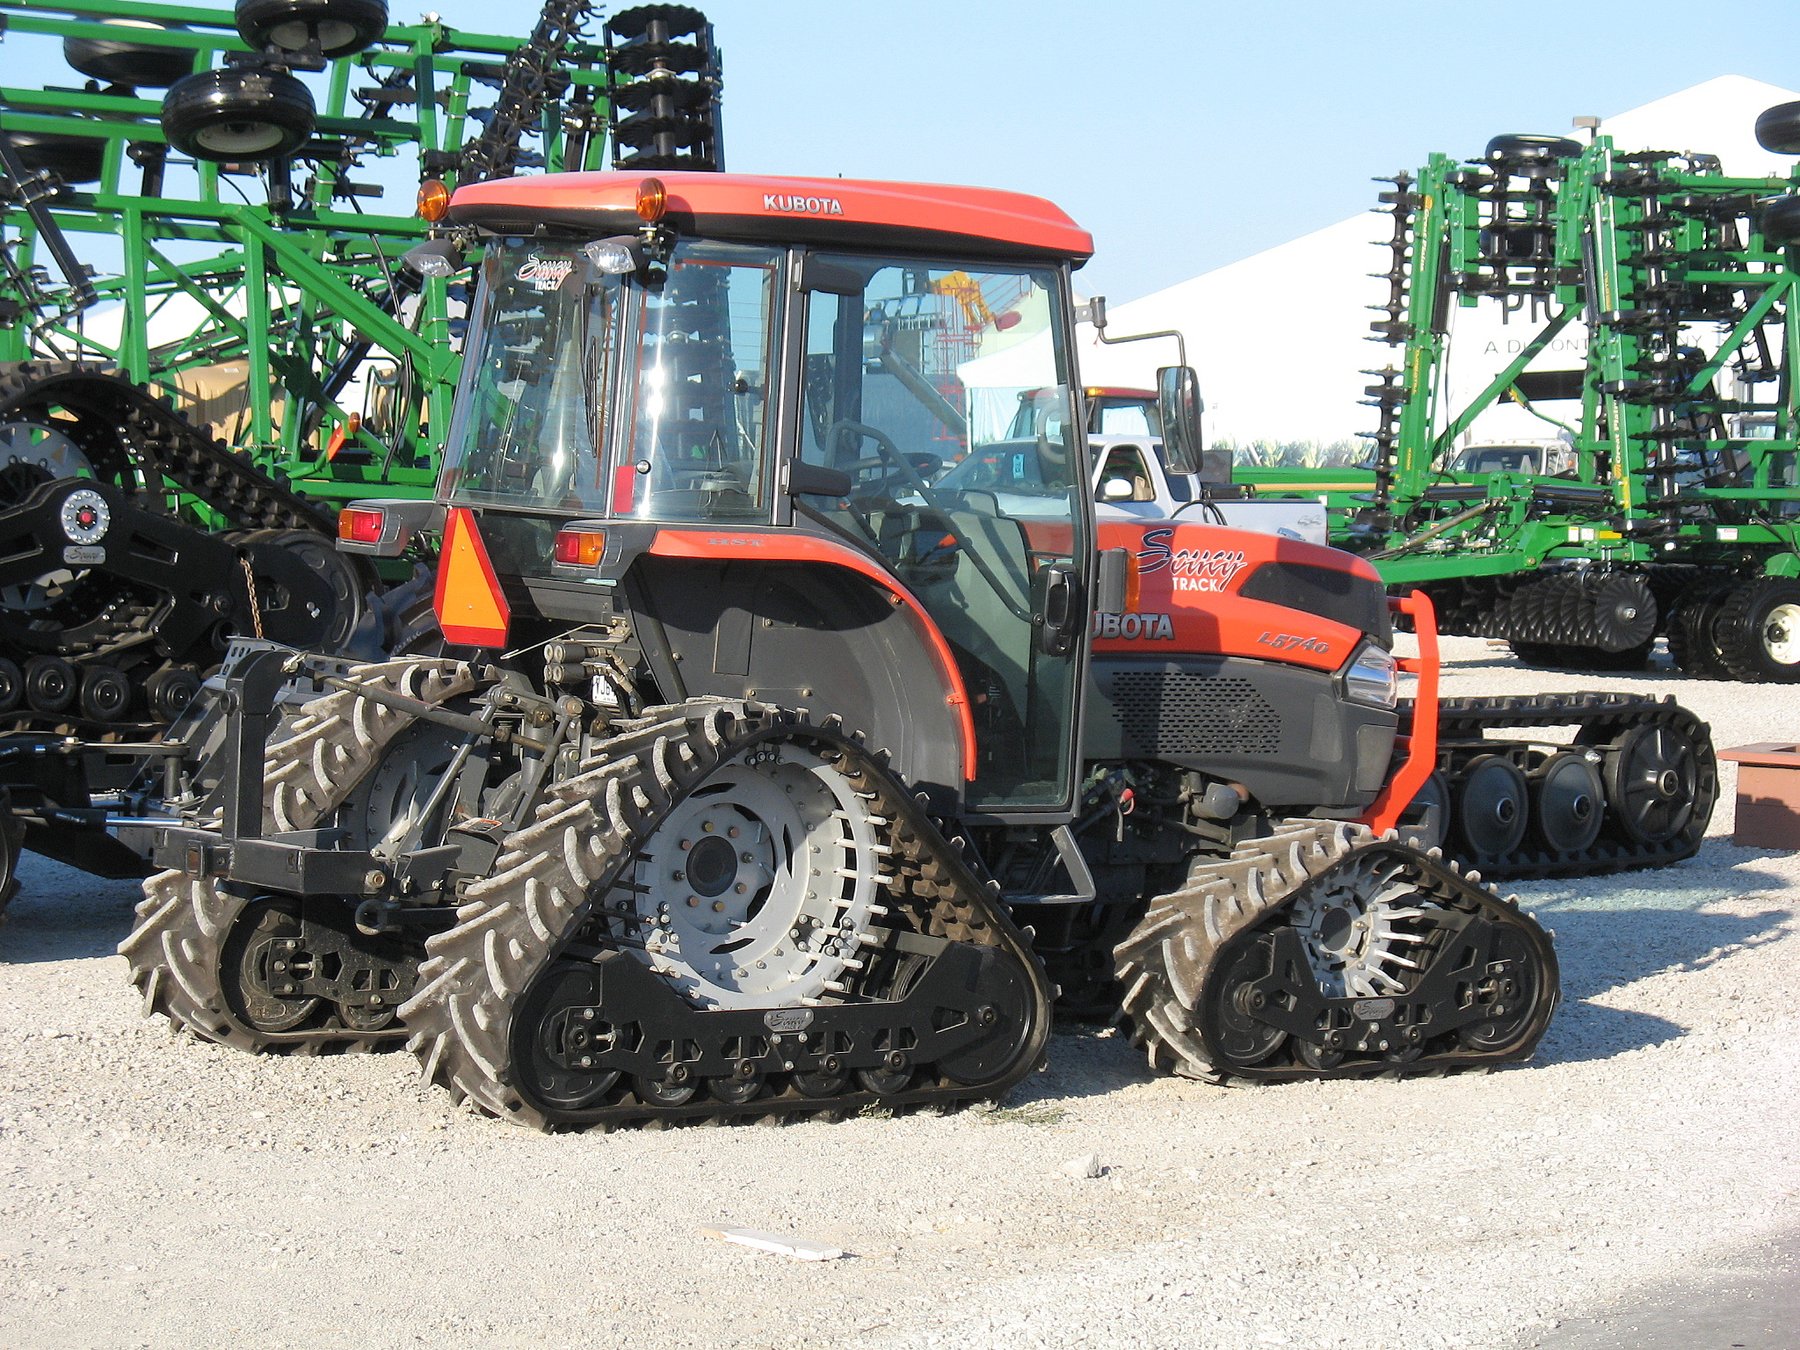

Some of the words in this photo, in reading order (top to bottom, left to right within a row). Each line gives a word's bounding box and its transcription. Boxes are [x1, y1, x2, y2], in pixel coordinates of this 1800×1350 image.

[763, 194, 845, 216] KUBOTA
[535, 280, 557, 291] TRACK
[1483, 340, 1499, 355] A
[1507, 338, 1589, 354] DONT
[708, 537, 763, 547] HST
[1136, 528, 1248, 593] Soucy
[1172, 577, 1219, 591] TRACK
[1091, 612, 1176, 641] UBOTA
[1256, 631, 1329, 654] L5740
